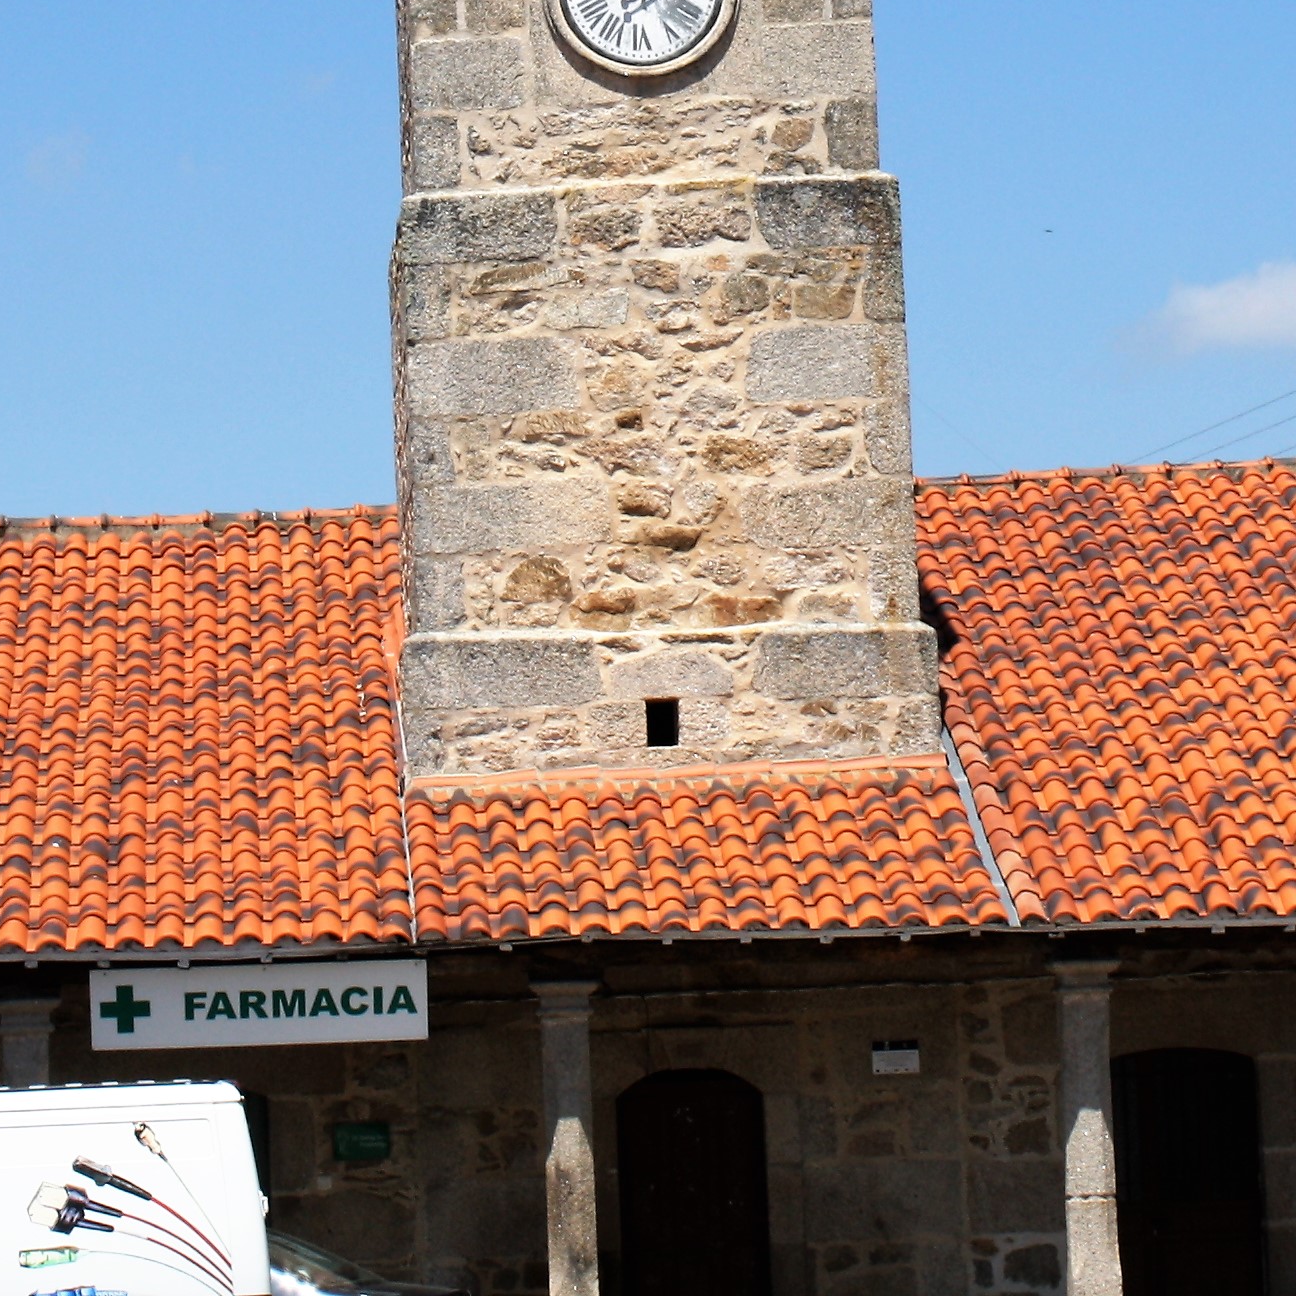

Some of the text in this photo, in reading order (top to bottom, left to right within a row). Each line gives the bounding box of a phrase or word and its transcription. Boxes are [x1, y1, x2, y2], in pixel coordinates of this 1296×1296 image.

[599, 13, 625, 48] VII
[632, 23, 652, 51] VI
[184, 985, 418, 1021] FARMACIA
